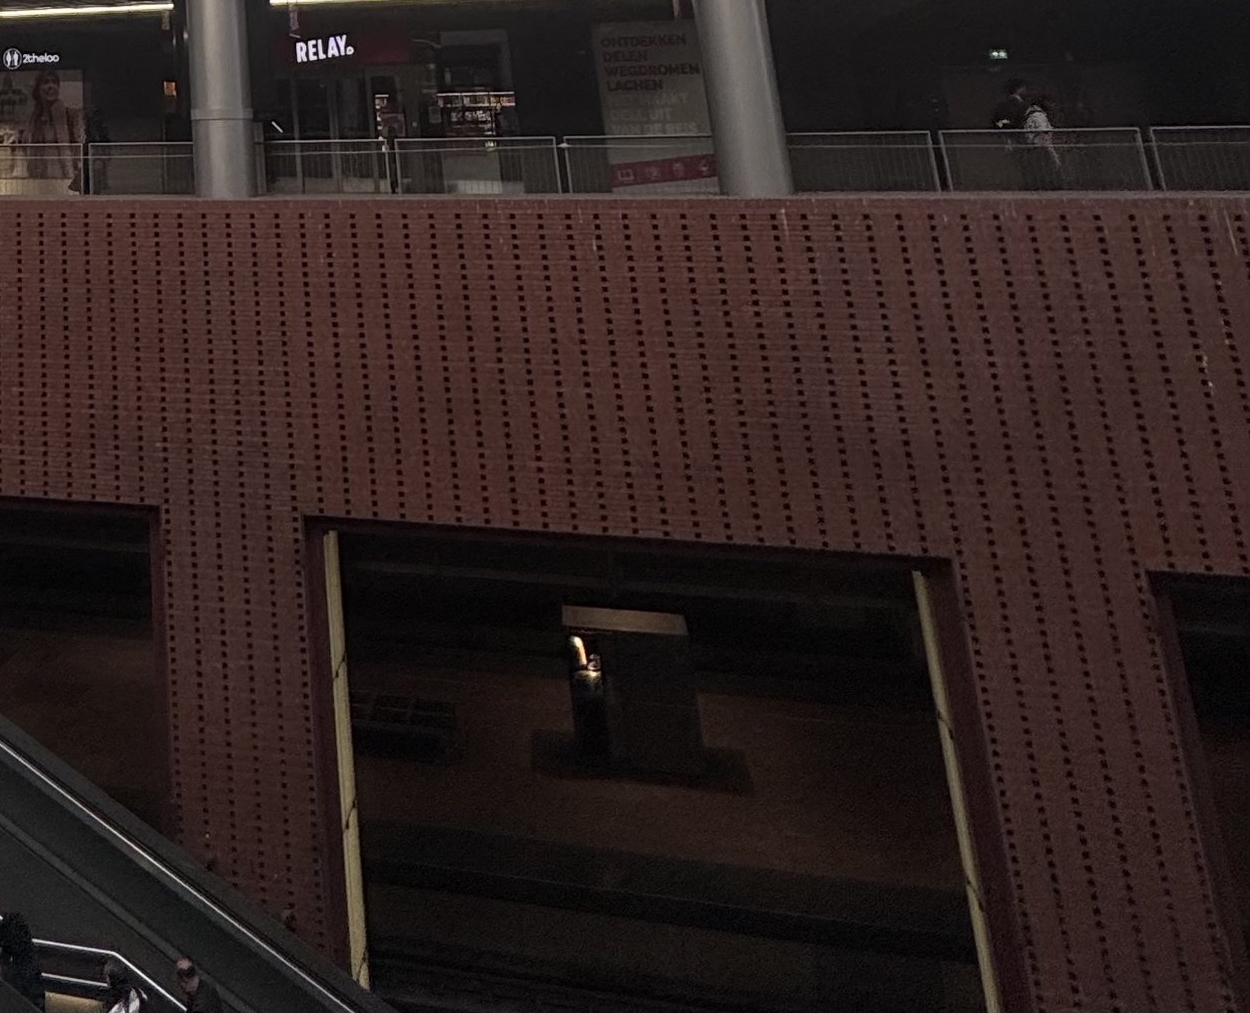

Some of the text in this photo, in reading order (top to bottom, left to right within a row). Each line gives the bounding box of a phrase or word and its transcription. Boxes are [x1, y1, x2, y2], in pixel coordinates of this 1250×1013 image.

[22, 52, 60, 64] 2theloo
[602, 50, 649, 63] DELEN
[604, 62, 701, 78] WEGDROMEN
